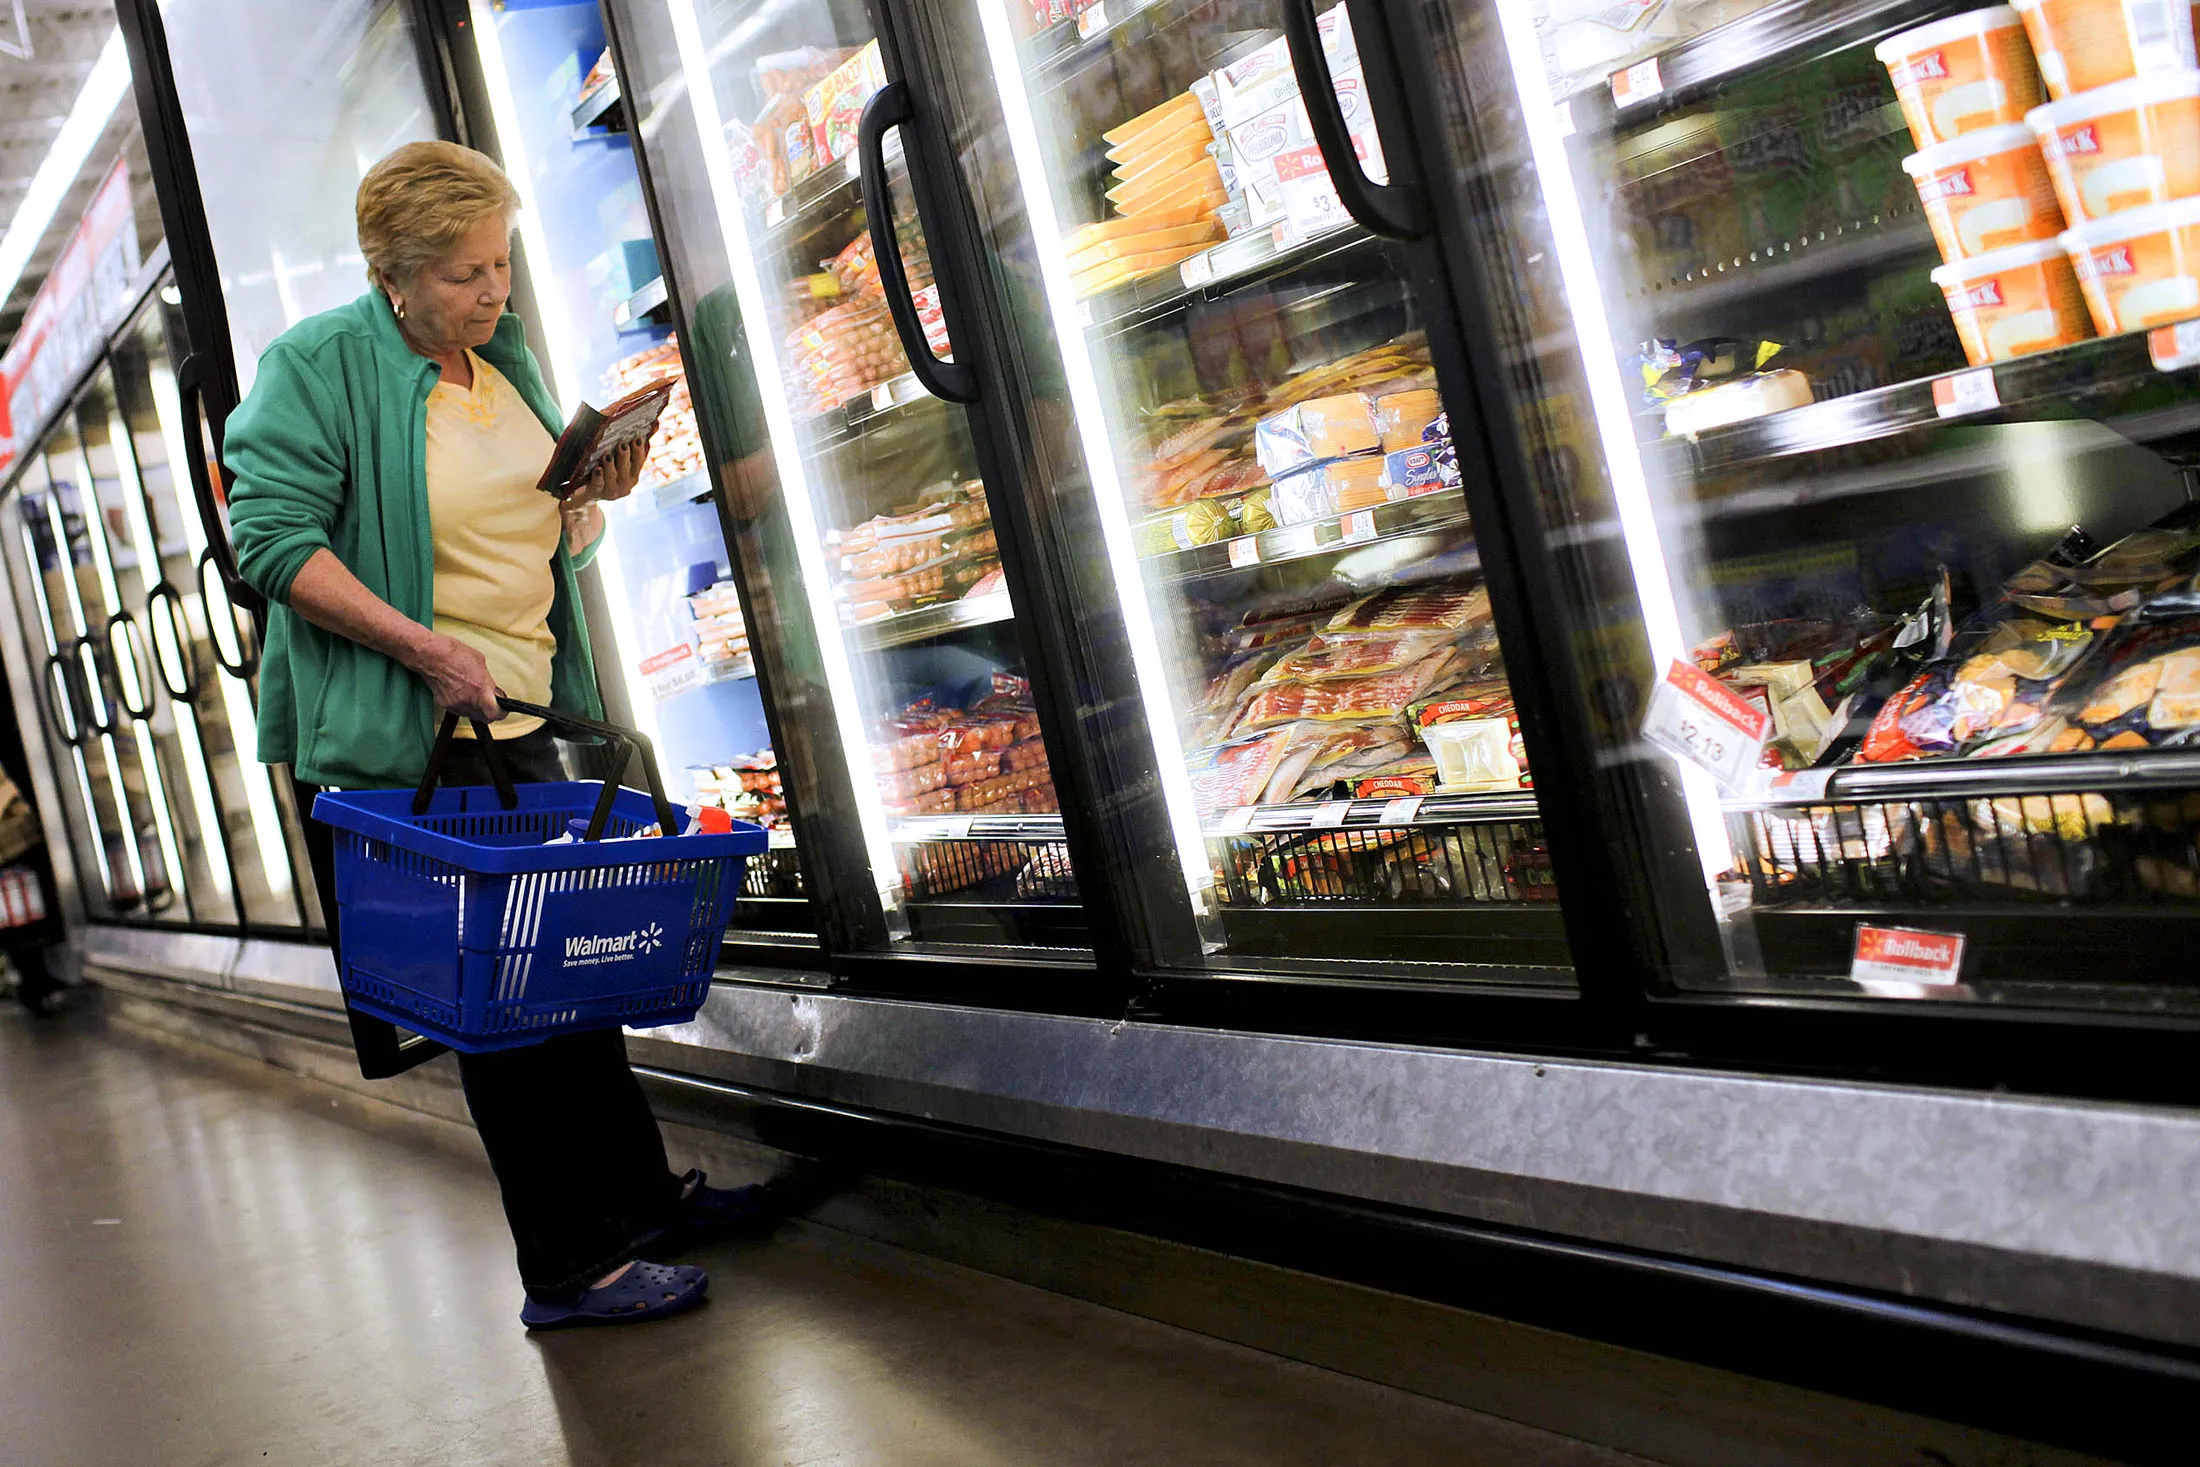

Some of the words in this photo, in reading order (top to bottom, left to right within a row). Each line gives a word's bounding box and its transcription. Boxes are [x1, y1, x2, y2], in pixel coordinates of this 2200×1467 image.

[1408, 456, 1427, 467] KRAFT
[1405, 468, 1438, 486] Singles
[1438, 701, 1471, 714] CHEDDAR
[1694, 679, 1760, 733] Rollback
[1681, 720, 1726, 761] $2.13
[1373, 779, 1403, 789] CHEDDAR
[565, 930, 638, 958] Walmart
[1883, 937, 1953, 963] Rollback
[562, 960, 578, 968] Save
[578, 957, 601, 967] money.
[601, 955, 614, 963] Live
[614, 953, 635, 962] better.
